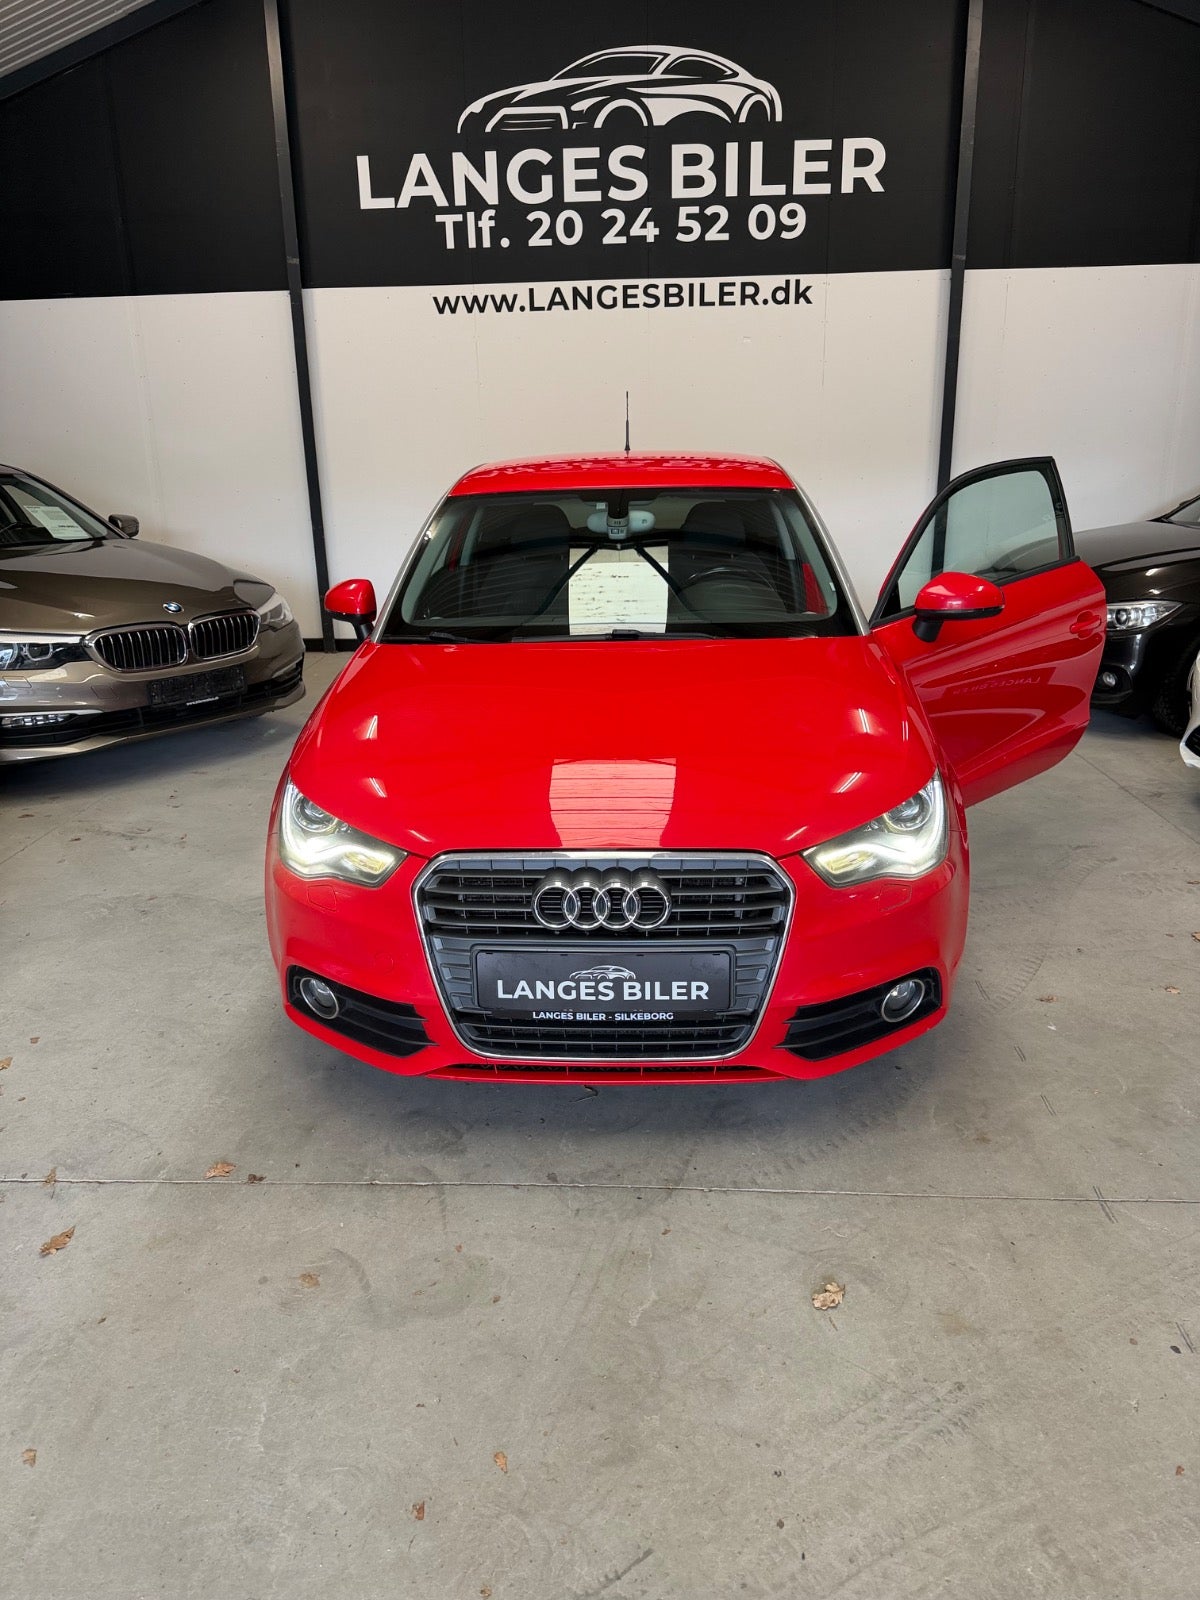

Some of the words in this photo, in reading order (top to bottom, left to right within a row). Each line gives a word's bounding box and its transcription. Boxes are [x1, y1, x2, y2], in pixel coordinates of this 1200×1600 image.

[356, 144, 649, 210] LANGES
[671, 137, 886, 199] BILER
[435, 209, 510, 250] Tlf.
[526, 209, 584, 247] 20
[601, 207, 660, 245] 24
[675, 205, 730, 243] 52
[747, 202, 807, 241] 09
[432, 278, 813, 315] www.LANGESBILER.dk
[496, 979, 615, 1002] LANGES
[622, 981, 710, 1001] BILER
[532, 1011, 574, 1021] LANGES
[576, 1012, 607, 1021] BILER
[614, 1012, 674, 1021] SILKEBORG
